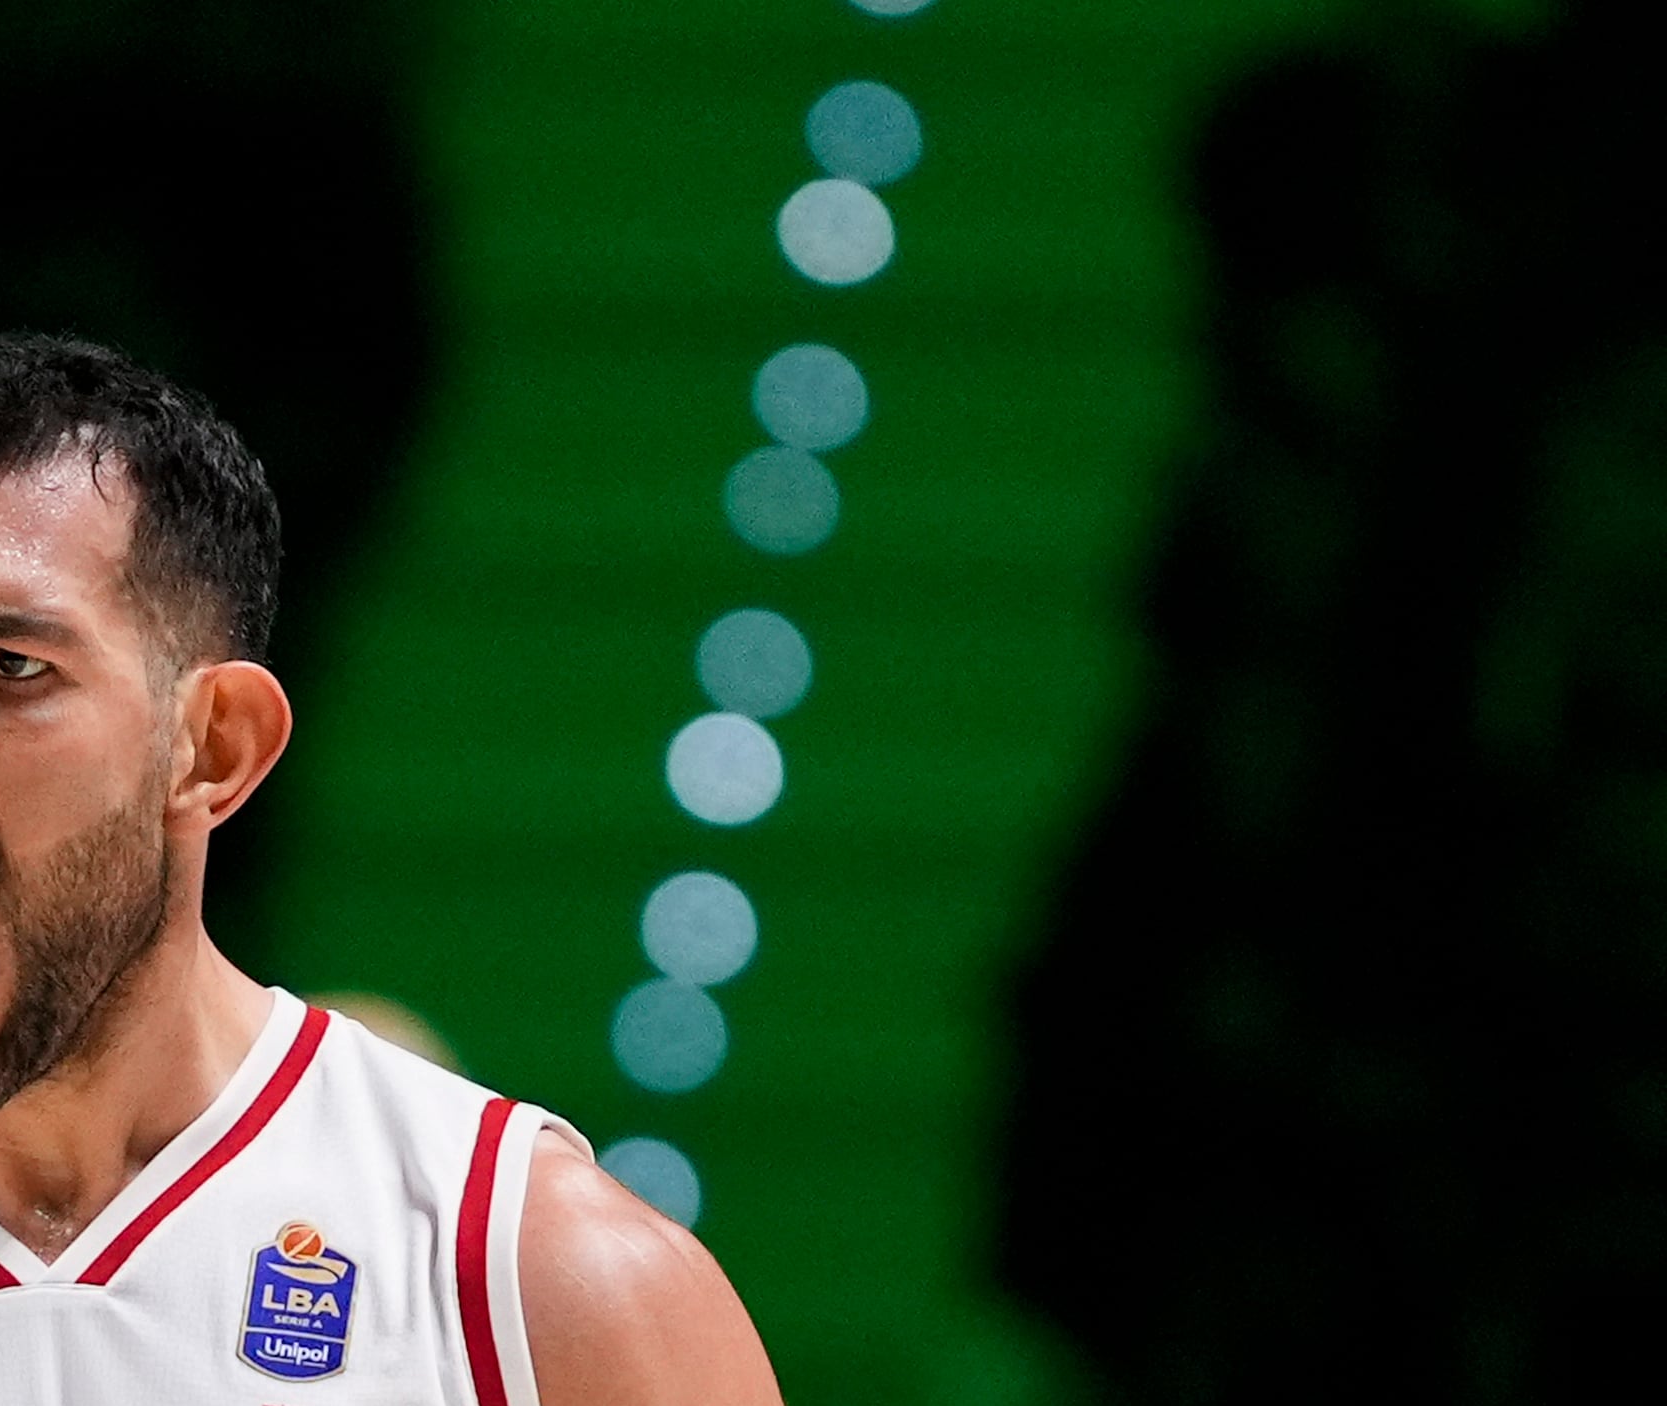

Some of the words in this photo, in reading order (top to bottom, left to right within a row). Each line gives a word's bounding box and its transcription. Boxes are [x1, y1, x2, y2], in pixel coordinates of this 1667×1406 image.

[262, 1284, 341, 1318] LBA
[274, 1314, 310, 1328] SERIE
[312, 1319, 323, 1329] A
[264, 1336, 329, 1366] Unipol
